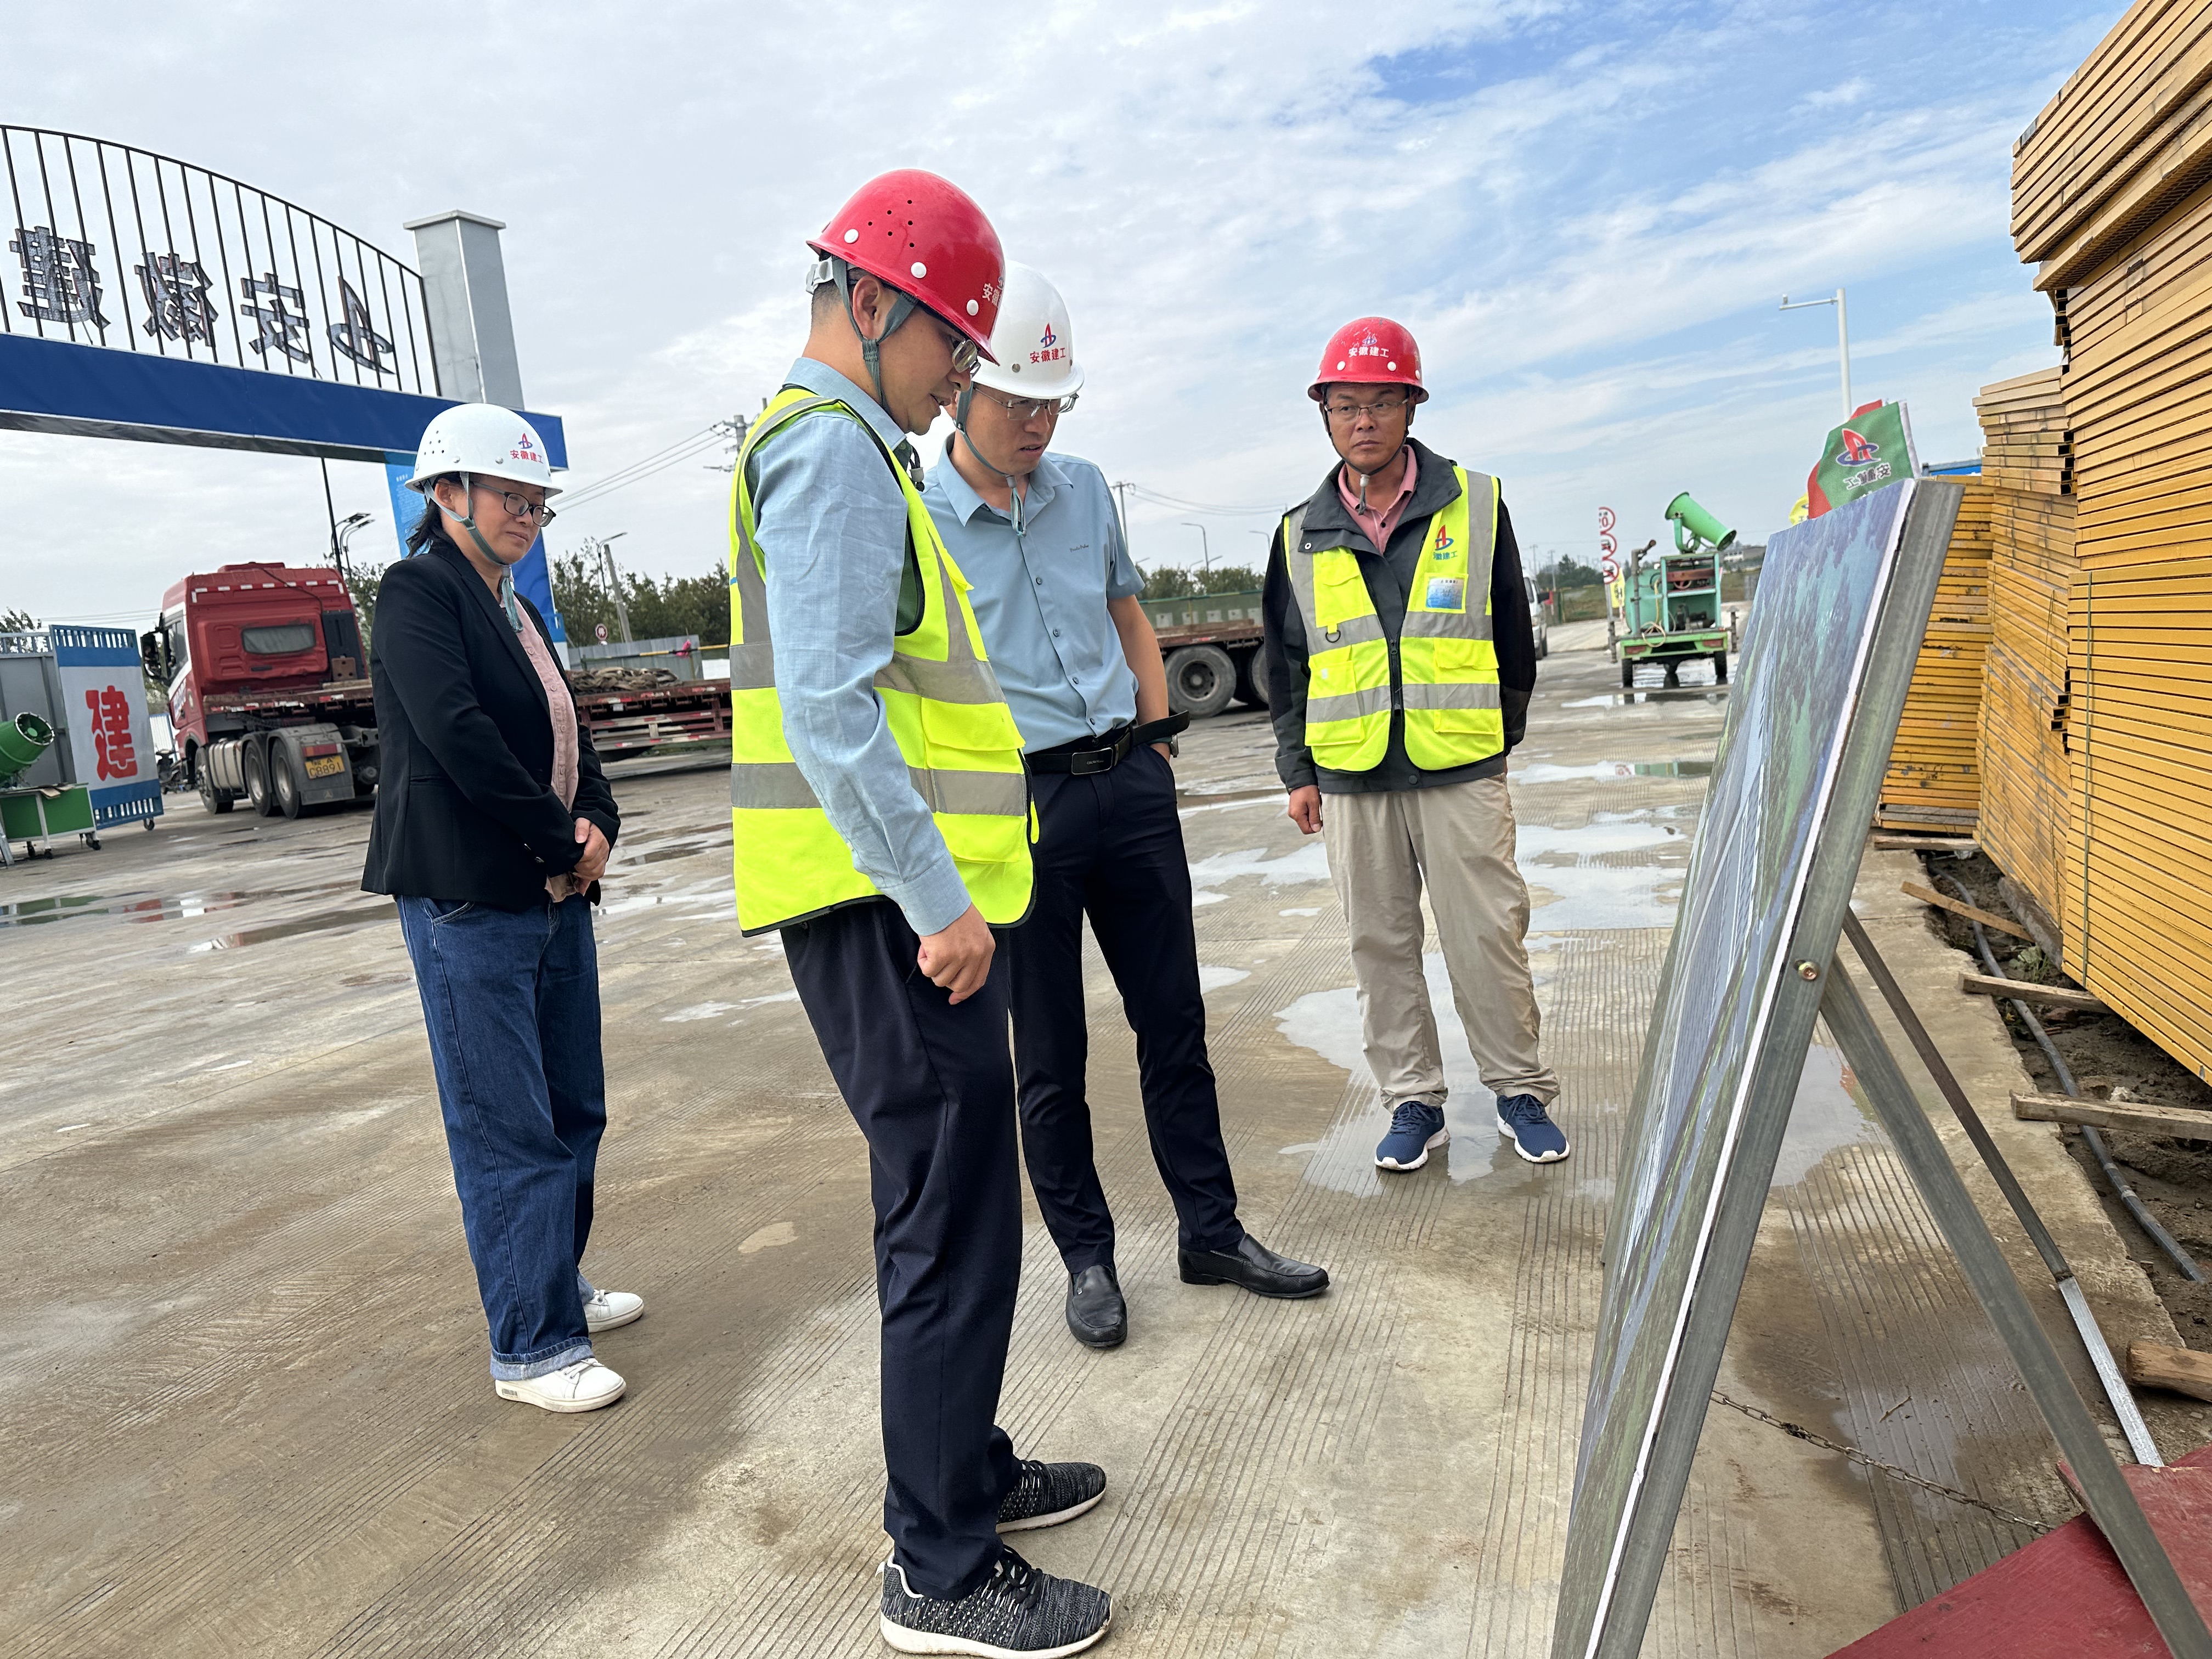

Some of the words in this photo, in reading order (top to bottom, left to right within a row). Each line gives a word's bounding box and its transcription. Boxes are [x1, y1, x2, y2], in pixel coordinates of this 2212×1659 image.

[1030, 347, 1066, 364] 安徽建工
[1348, 346, 1389, 358] 安徽建工
[510, 449, 544, 464] 安徽建工
[86, 685, 138, 781] 建
